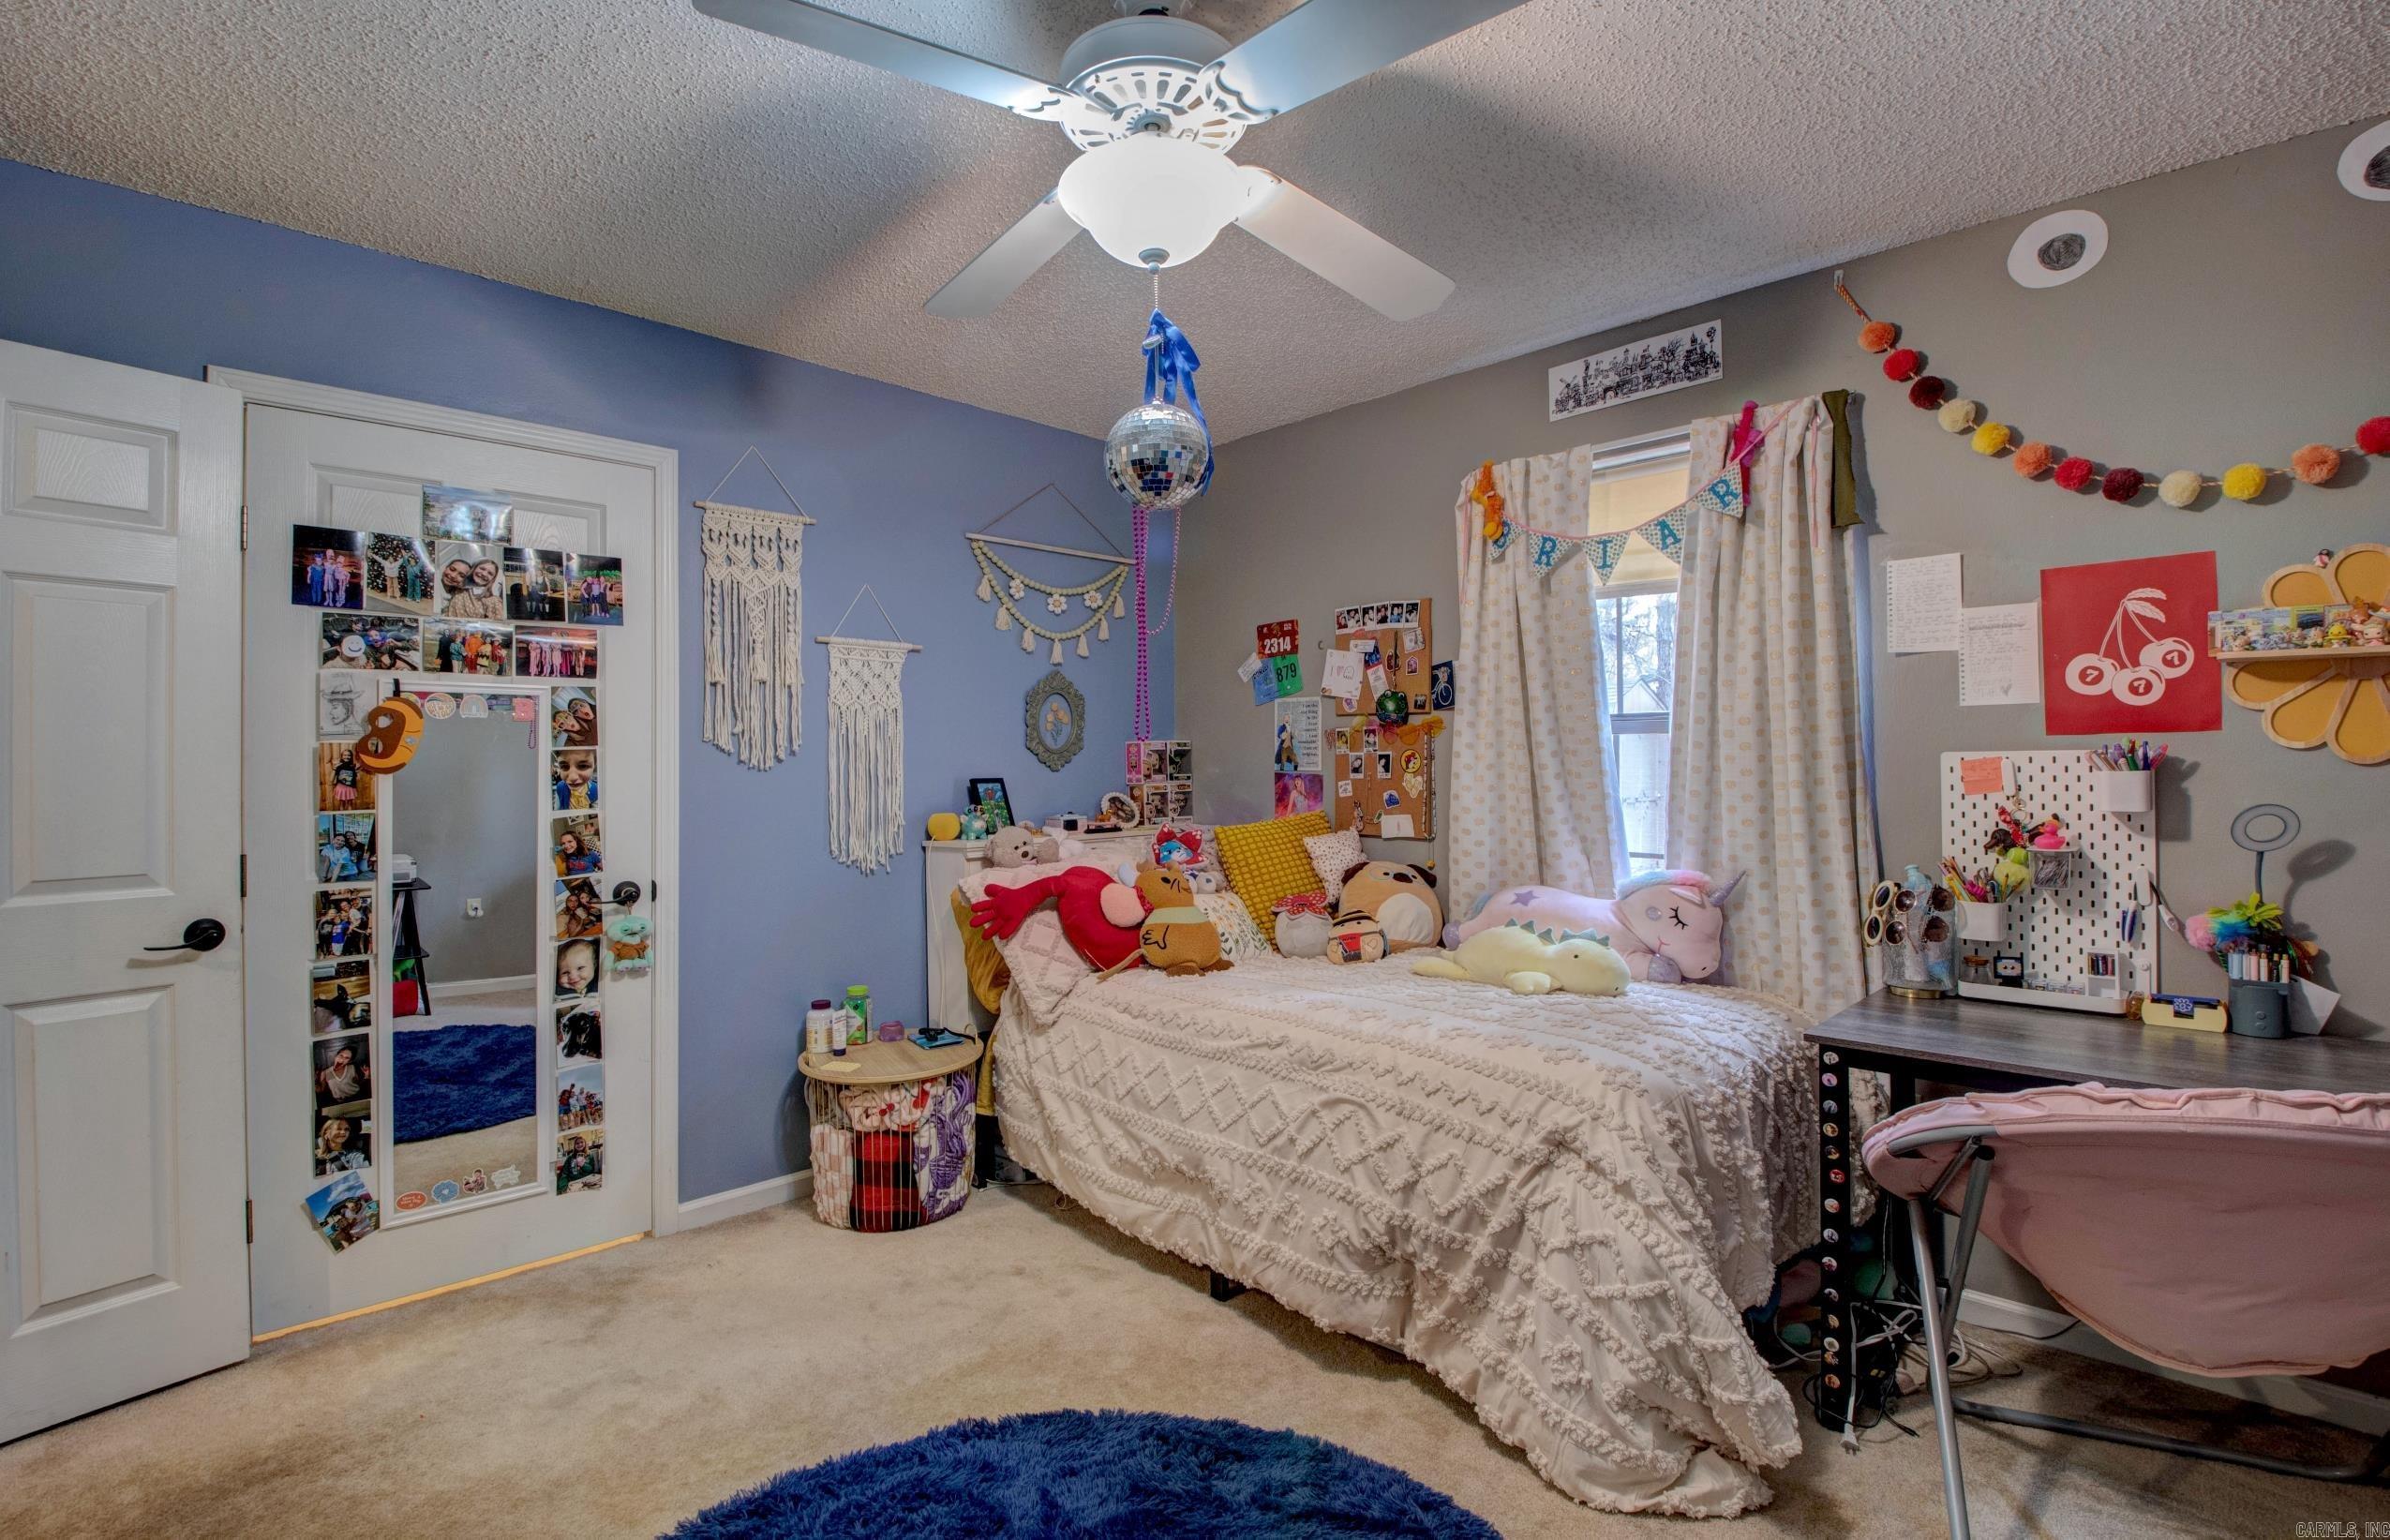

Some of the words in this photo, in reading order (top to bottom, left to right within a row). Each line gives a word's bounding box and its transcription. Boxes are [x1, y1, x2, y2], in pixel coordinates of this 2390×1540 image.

[1263, 635, 1292, 654] 2314
[2165, 650, 2181, 665] 7
[1276, 663, 1297, 682] 879
[2084, 668, 2100, 682] 7
[2132, 679, 2147, 694] 7
